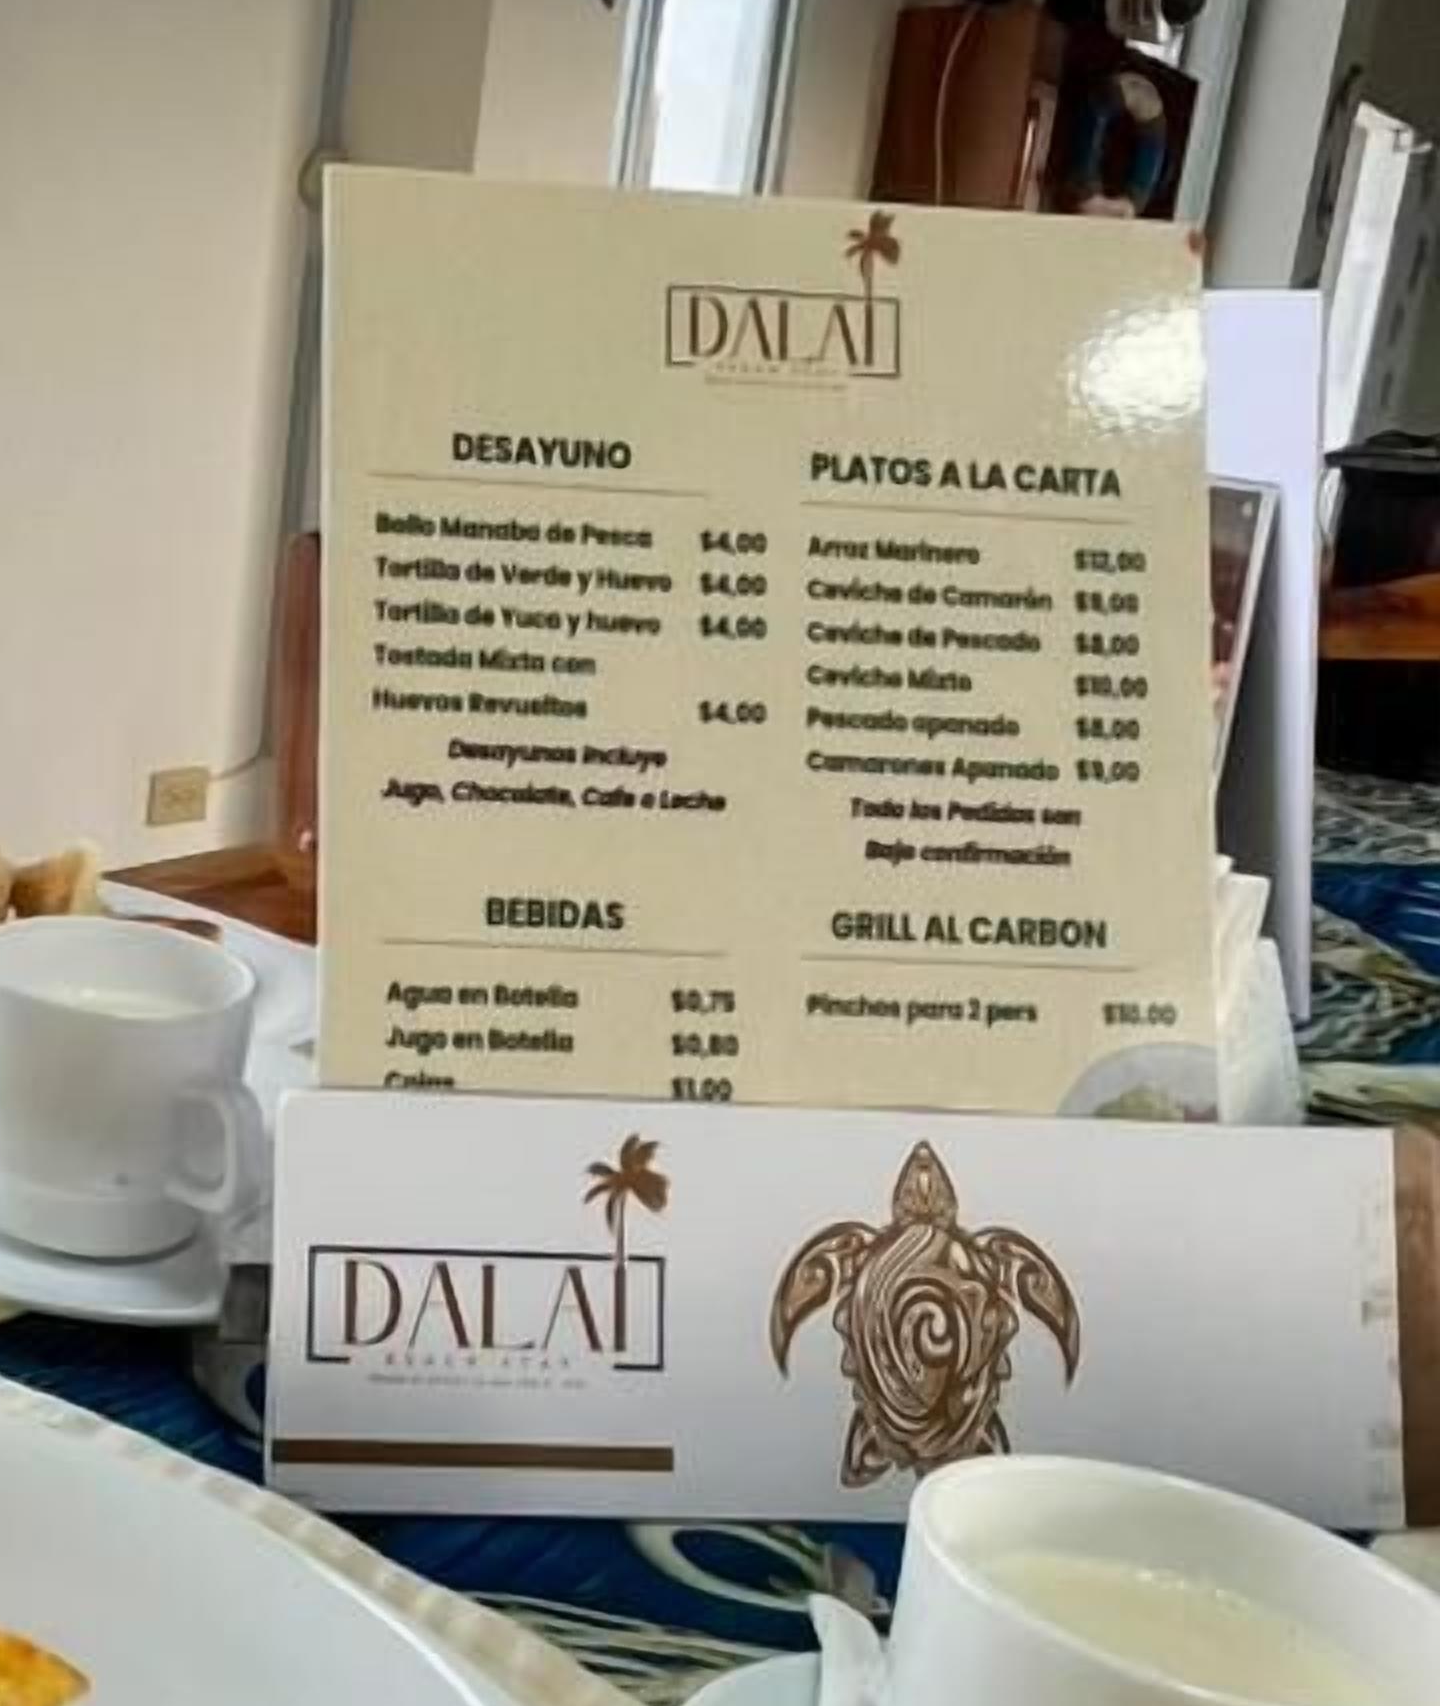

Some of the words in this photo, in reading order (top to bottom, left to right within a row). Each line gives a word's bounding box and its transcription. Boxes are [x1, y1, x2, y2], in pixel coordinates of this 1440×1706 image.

[453, 433, 631, 469] DESAYUNO
[811, 452, 932, 487] PLATOS
[939, 461, 961, 488] A
[968, 461, 1007, 490] LA
[1013, 464, 1120, 497] CARTA
[486, 897, 624, 930] BEBIDAS
[831, 911, 917, 941] GRILL
[924, 915, 962, 944] AL
[969, 917, 1106, 948] CARBON
